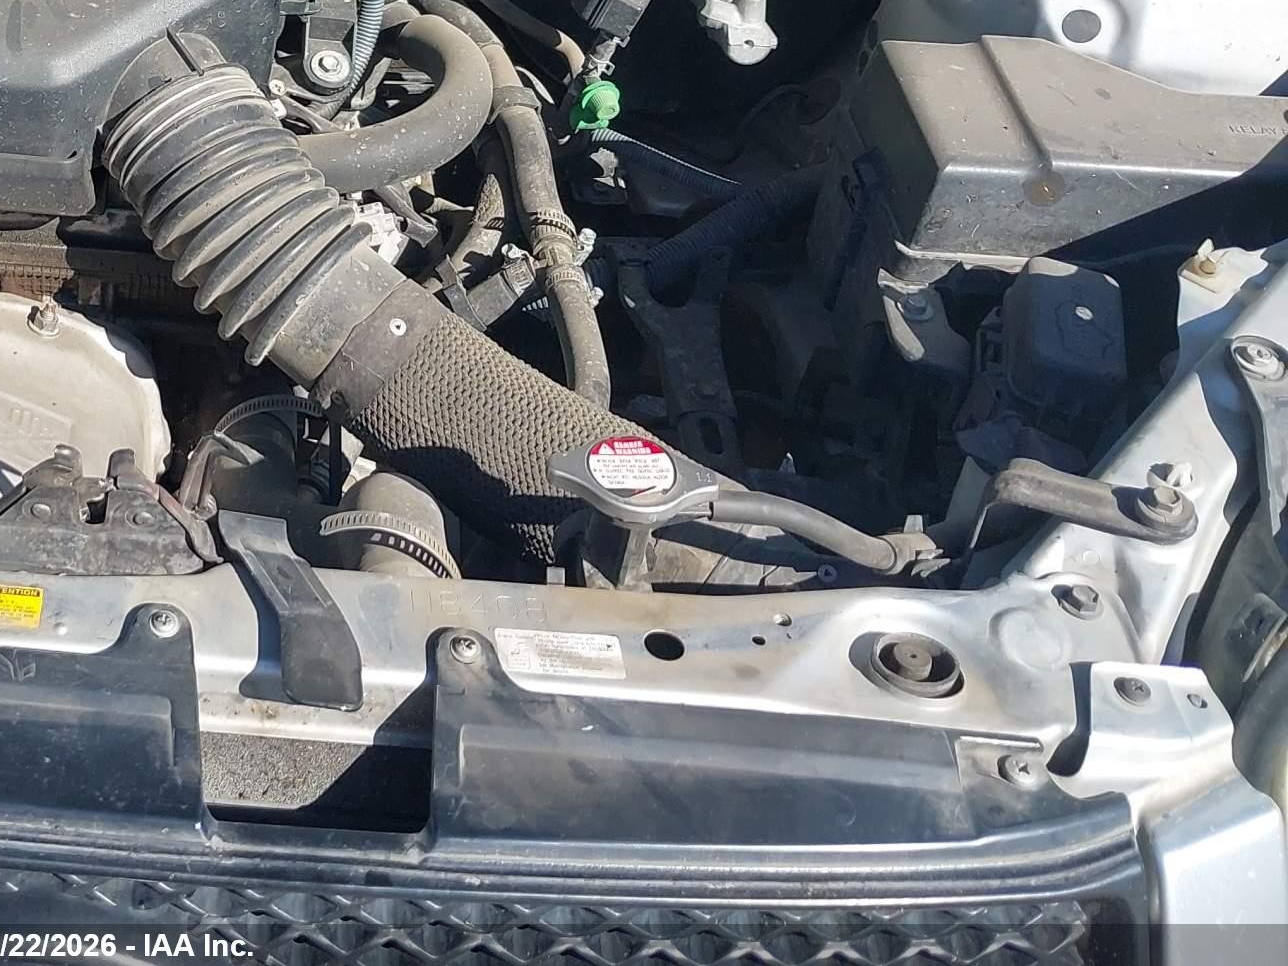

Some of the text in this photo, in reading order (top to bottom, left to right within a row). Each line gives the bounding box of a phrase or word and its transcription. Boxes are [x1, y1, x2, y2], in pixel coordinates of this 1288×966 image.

[1227, 124, 1277, 136] RELAY
[615, 447, 652, 455] WARNING
[695, 471, 713, 483] 1.1
